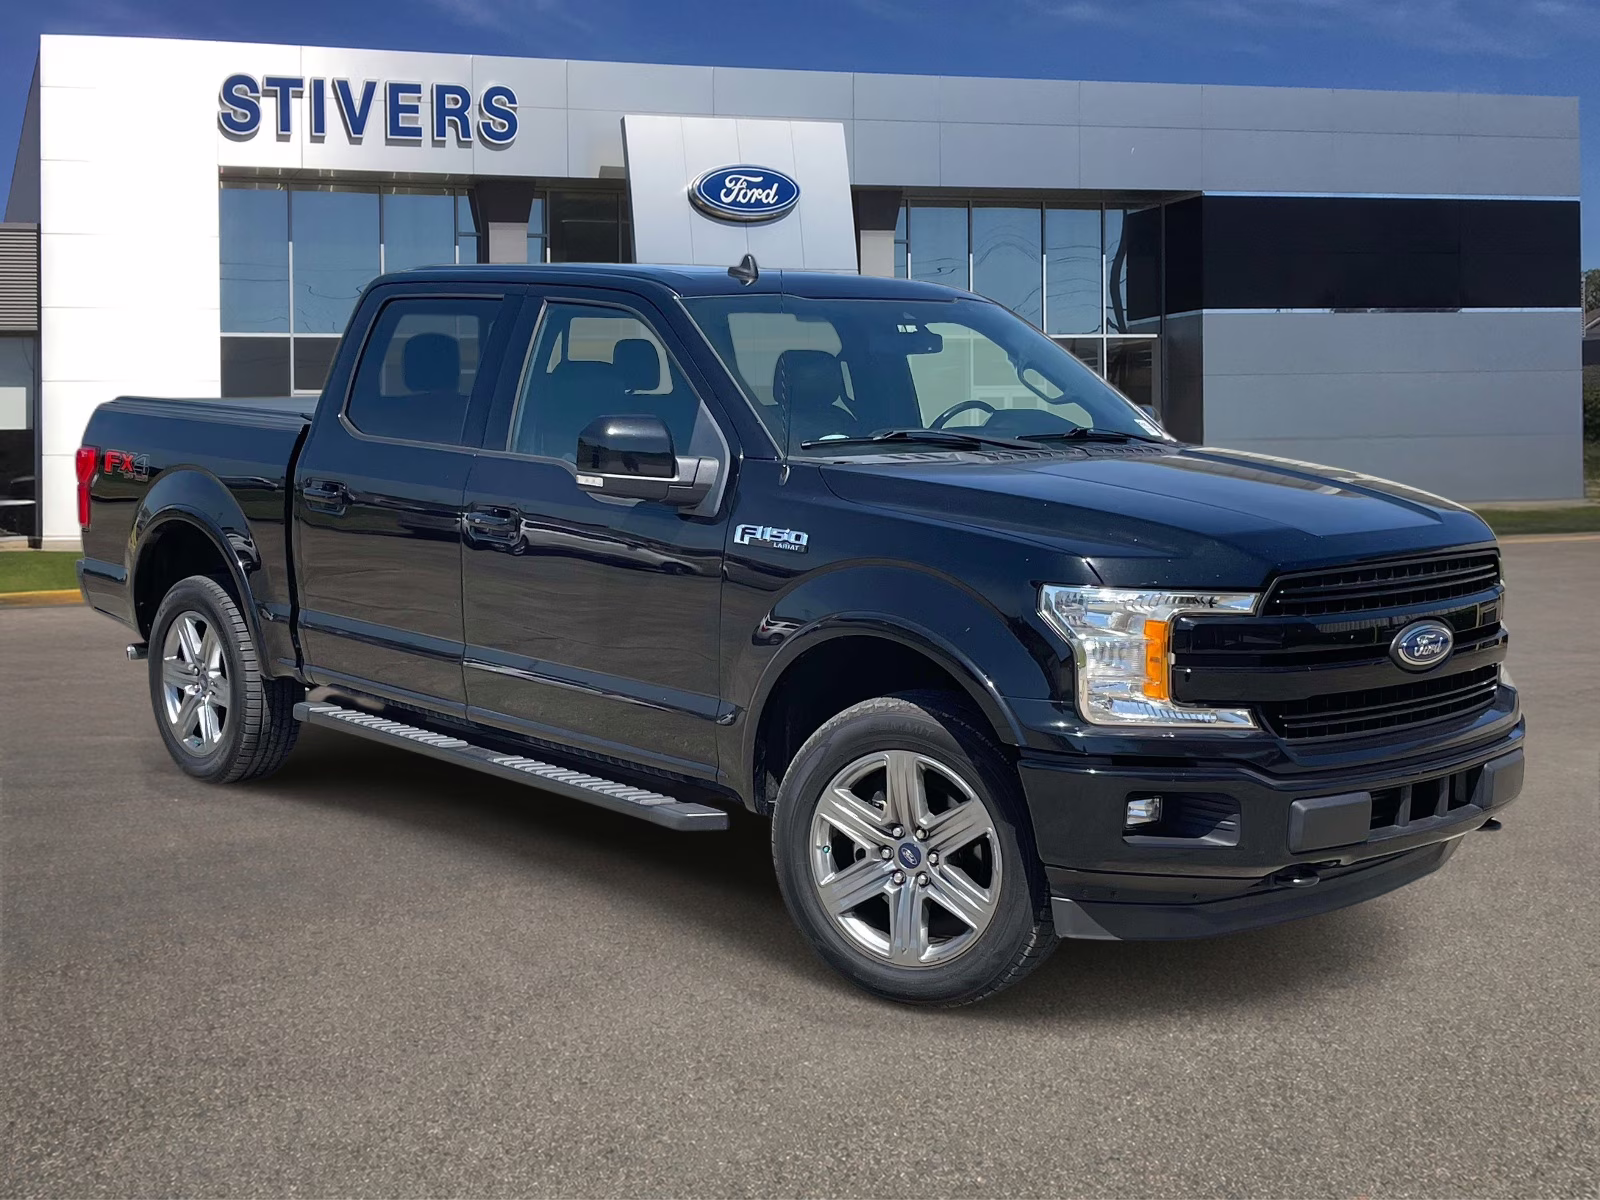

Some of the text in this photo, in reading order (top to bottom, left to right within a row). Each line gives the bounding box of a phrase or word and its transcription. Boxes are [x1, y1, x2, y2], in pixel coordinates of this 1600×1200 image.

[218, 73, 518, 147] STIVERS
[720, 174, 779, 204] Ford
[104, 449, 150, 477] FX4
[773, 541, 799, 551] LARIAT
[1414, 634, 1443, 656] Ford
